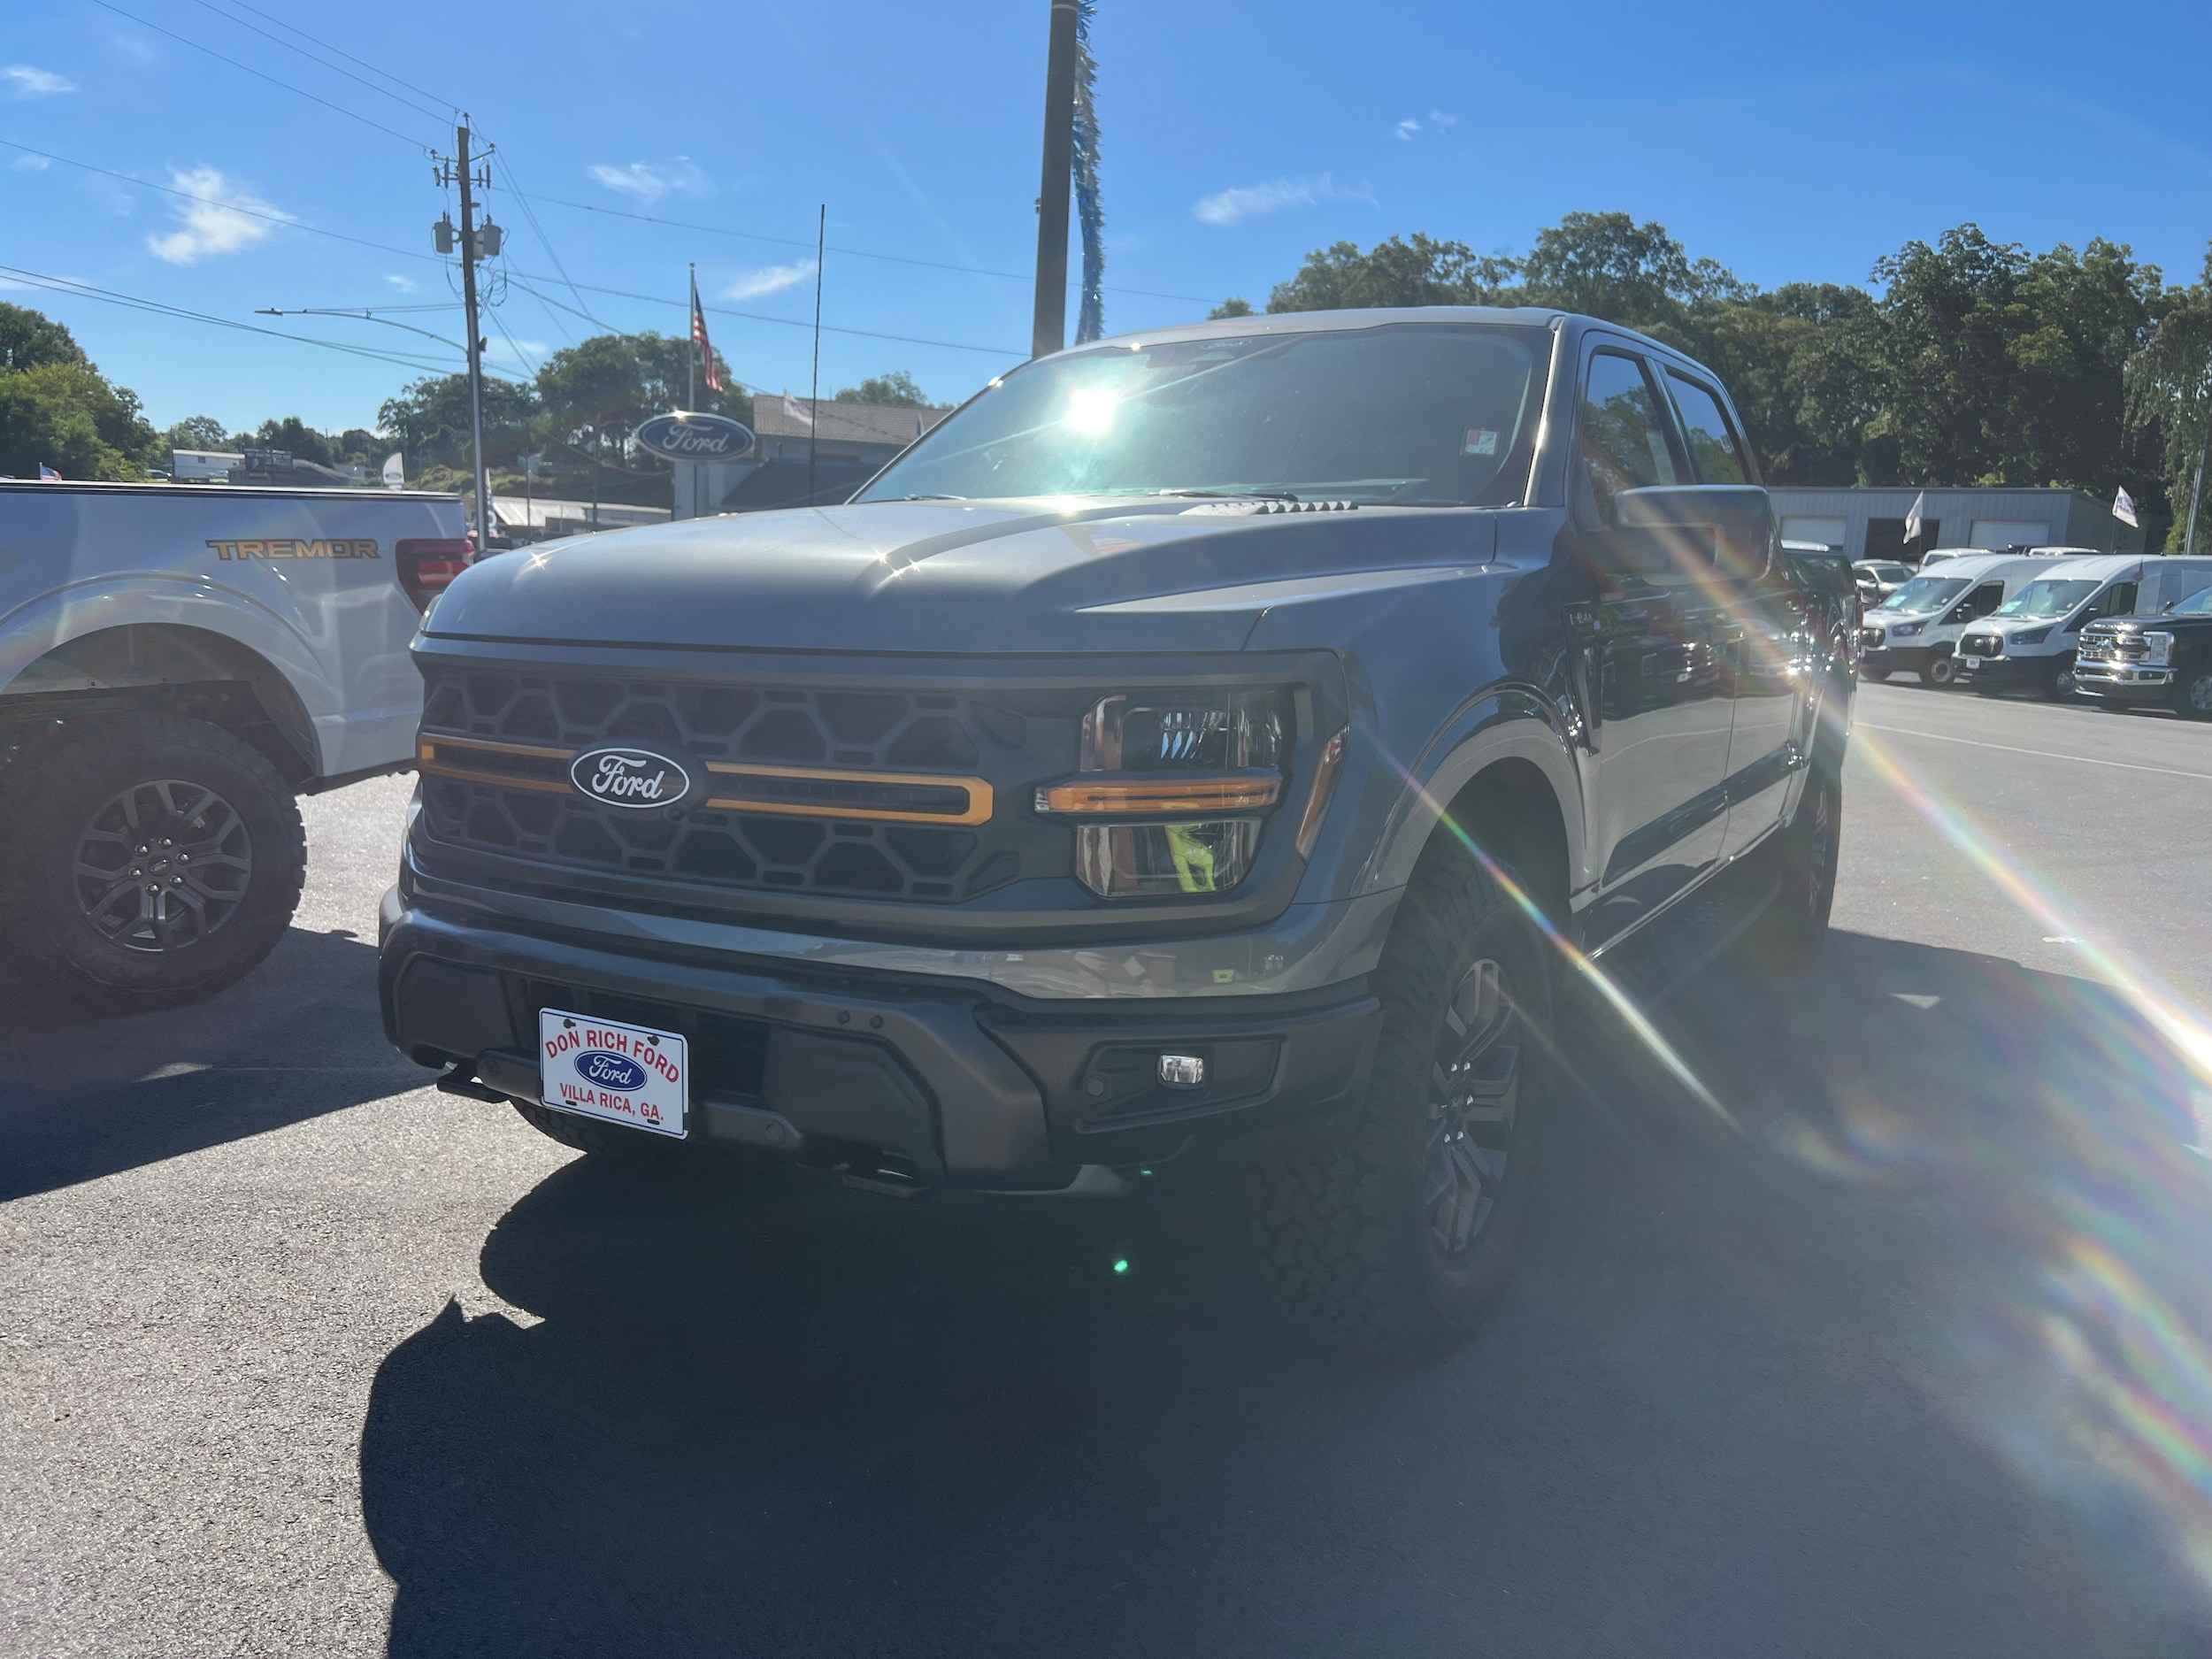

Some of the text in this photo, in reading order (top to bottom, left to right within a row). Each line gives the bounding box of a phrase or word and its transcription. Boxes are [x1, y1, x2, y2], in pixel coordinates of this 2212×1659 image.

[663, 424, 729, 452] Ford
[205, 539, 380, 560] TREMOR
[592, 755, 664, 799] Ford
[546, 1030, 680, 1083] DON RICH FORD
[588, 1055, 633, 1085] Ford
[559, 1082, 664, 1120] VILLA RICA, GA.
